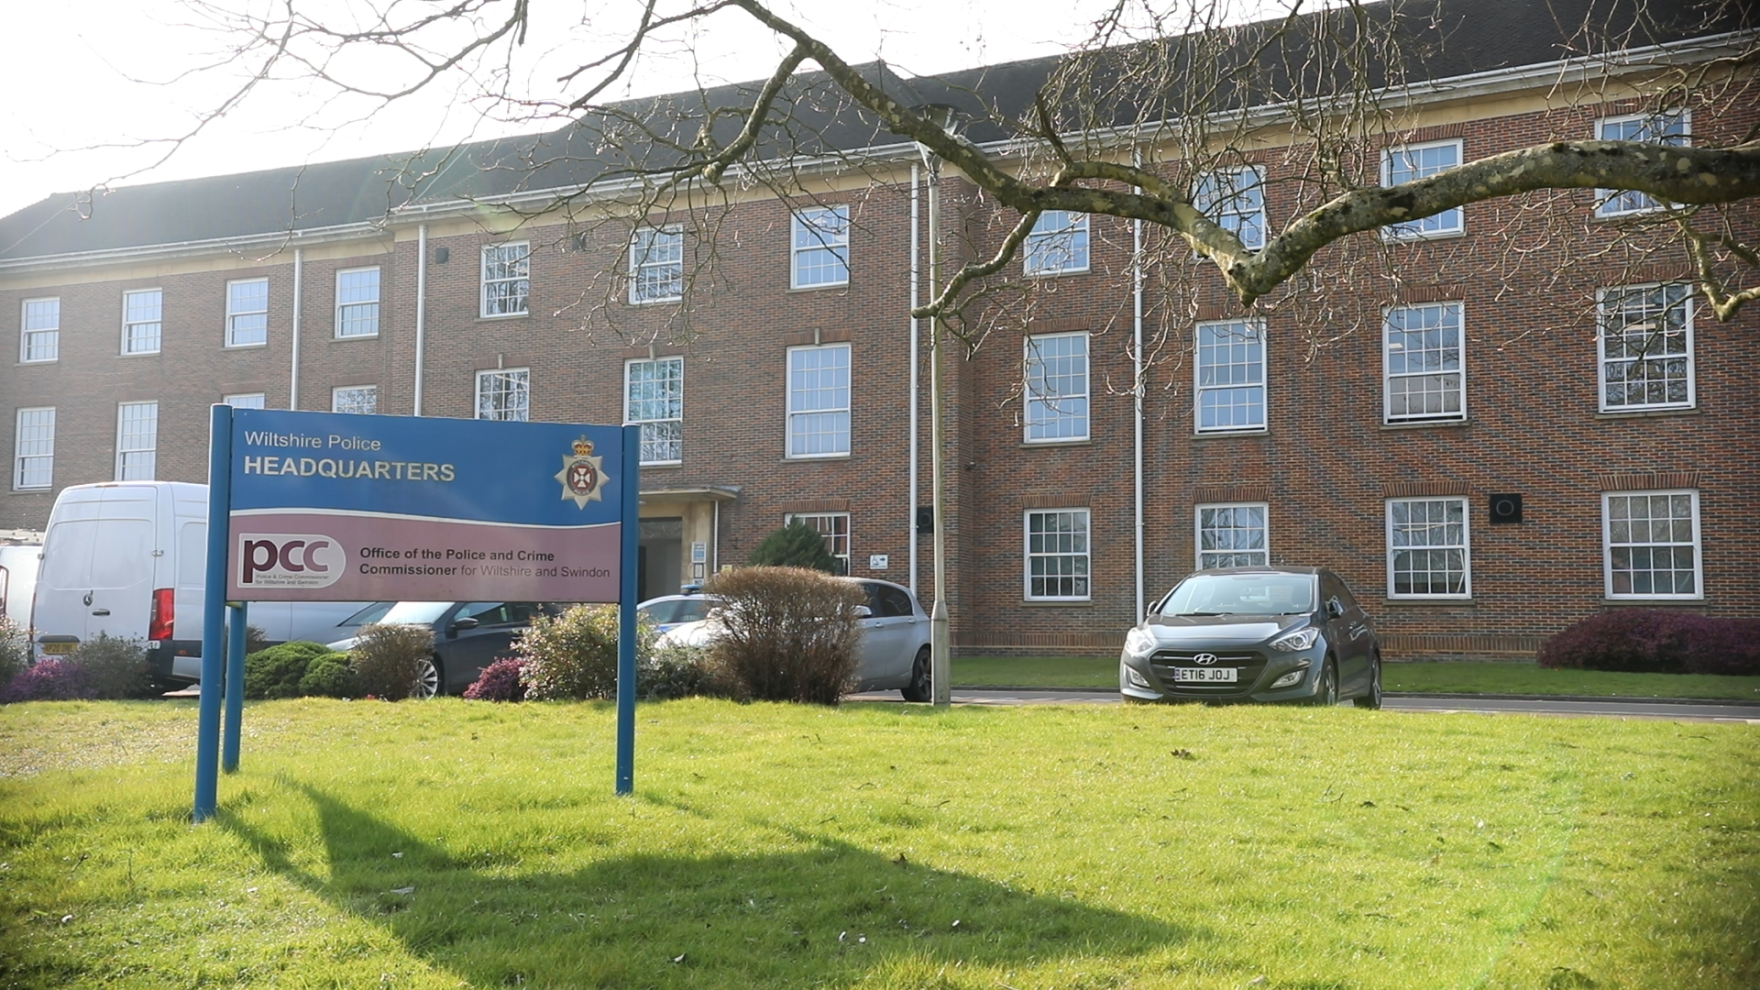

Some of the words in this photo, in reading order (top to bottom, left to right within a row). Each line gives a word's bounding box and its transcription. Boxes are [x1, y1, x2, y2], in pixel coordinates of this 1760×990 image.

[244, 430, 322, 449] Wiltshire
[328, 434, 381, 451] Police
[244, 455, 455, 481] HEADQUARTERS
[242, 540, 329, 583] pcc
[360, 547, 400, 559] Office
[404, 548, 418, 559] of
[421, 549, 442, 559] the
[446, 549, 486, 560] Police
[490, 551, 513, 561] and
[517, 550, 555, 561] Crime
[359, 563, 457, 575] Commissioner
[461, 565, 477, 576] for
[480, 565, 532, 577] Wiltshire
[535, 567, 557, 577] and
[561, 566, 610, 578] Swindon
[1181, 669, 1205, 680] ET16
[1209, 669, 1230, 680] JOJ
